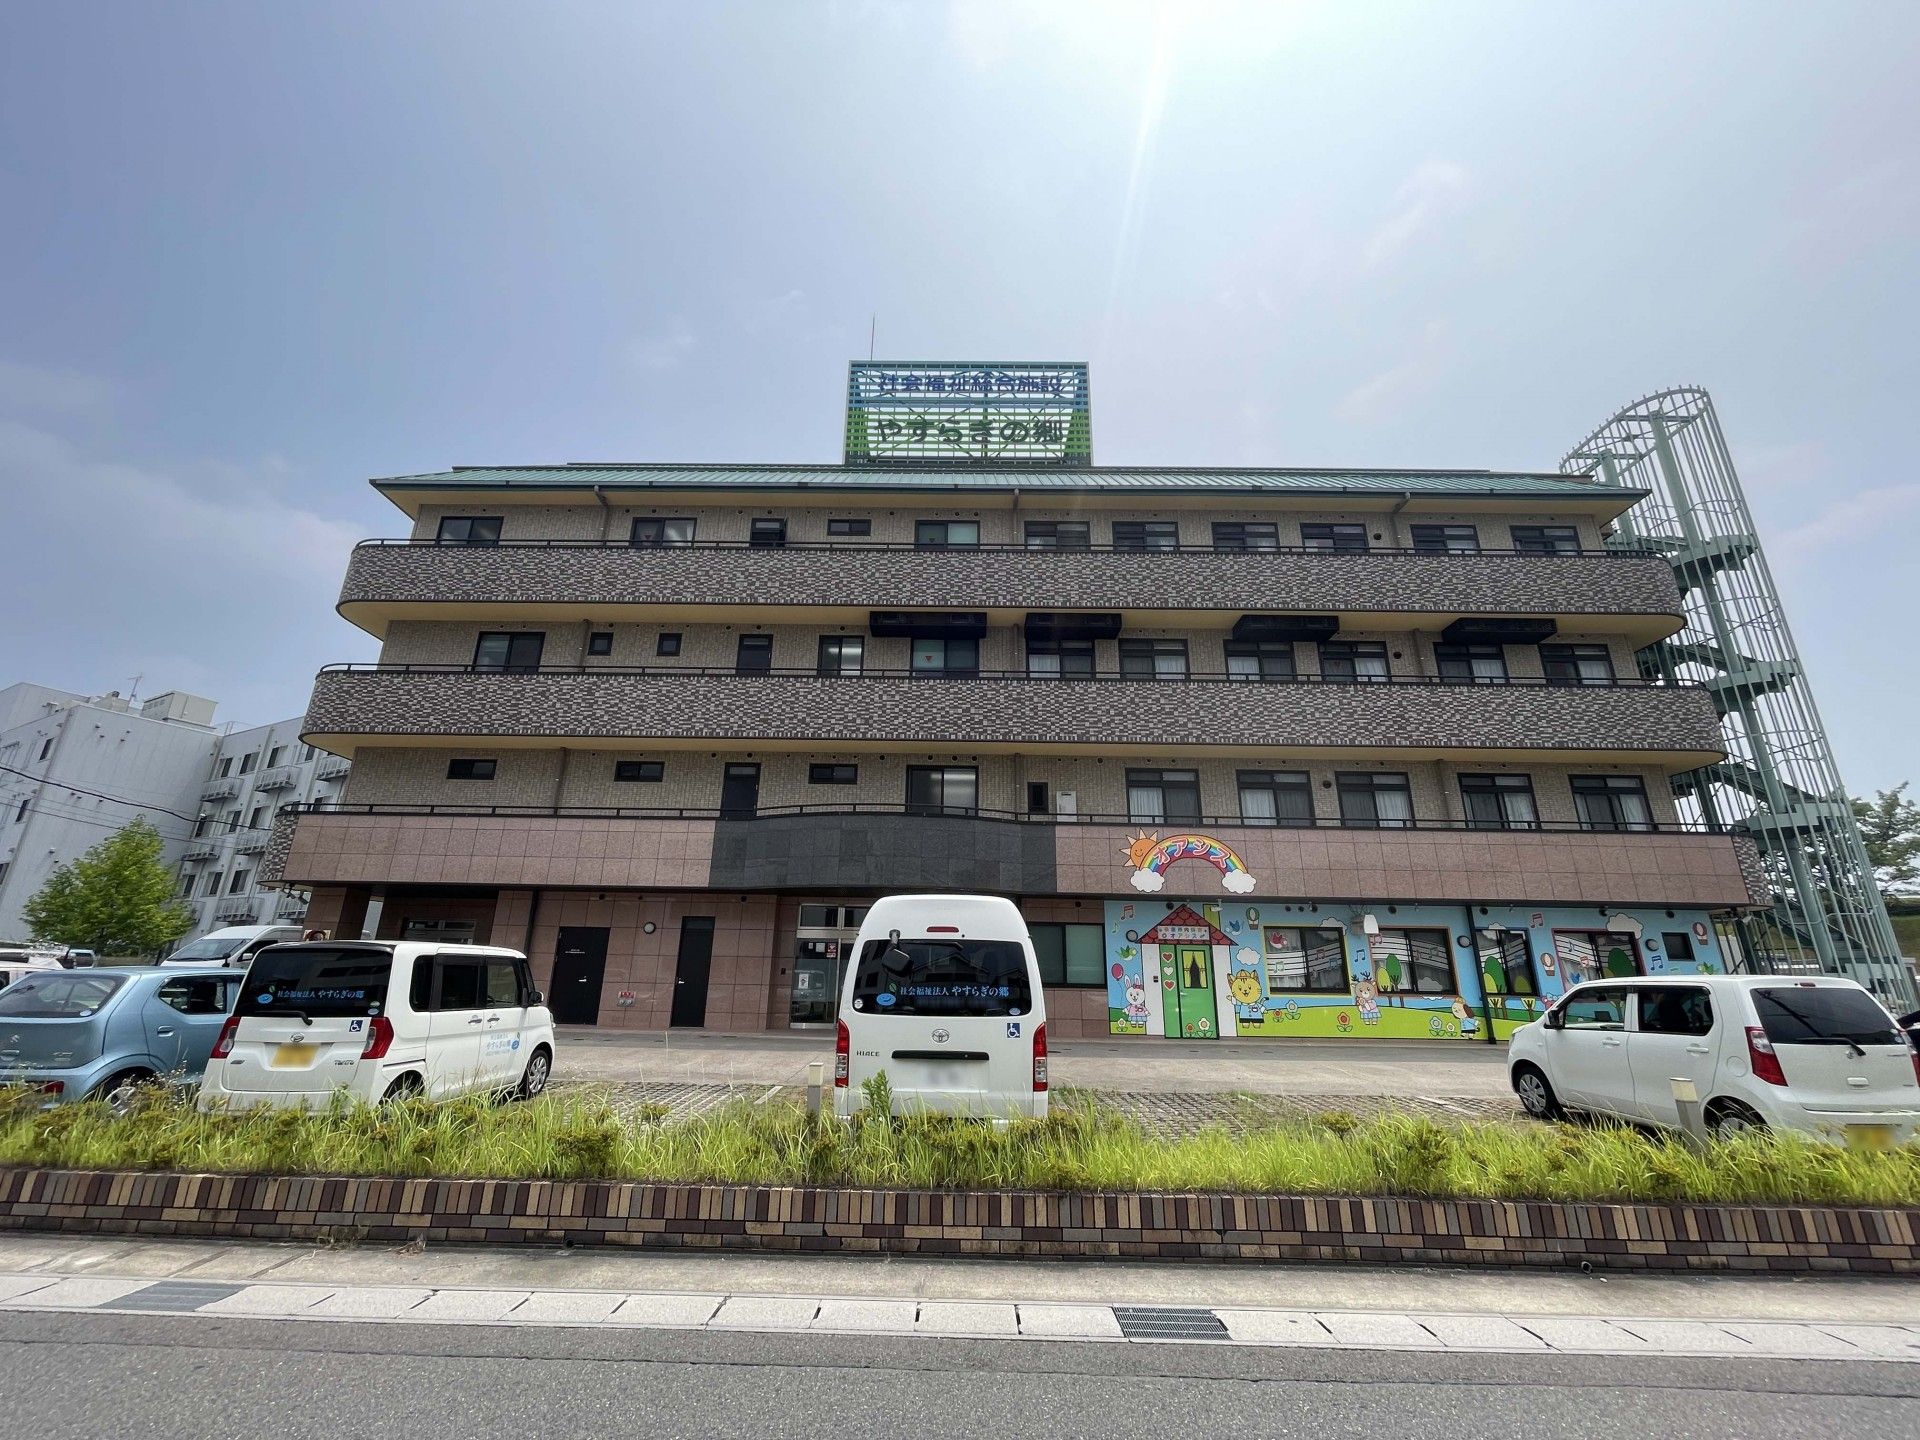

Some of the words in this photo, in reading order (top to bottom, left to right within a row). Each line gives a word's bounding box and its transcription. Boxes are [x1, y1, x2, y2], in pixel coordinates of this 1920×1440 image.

[879, 373, 1060, 393] 社会福祉総合施設
[876, 417, 1063, 443] やすらぎの郷
[1153, 837, 1230, 869] オアシス
[900, 986, 949, 996] 社会福祉法人
[951, 985, 1009, 997] やすらぎの郷
